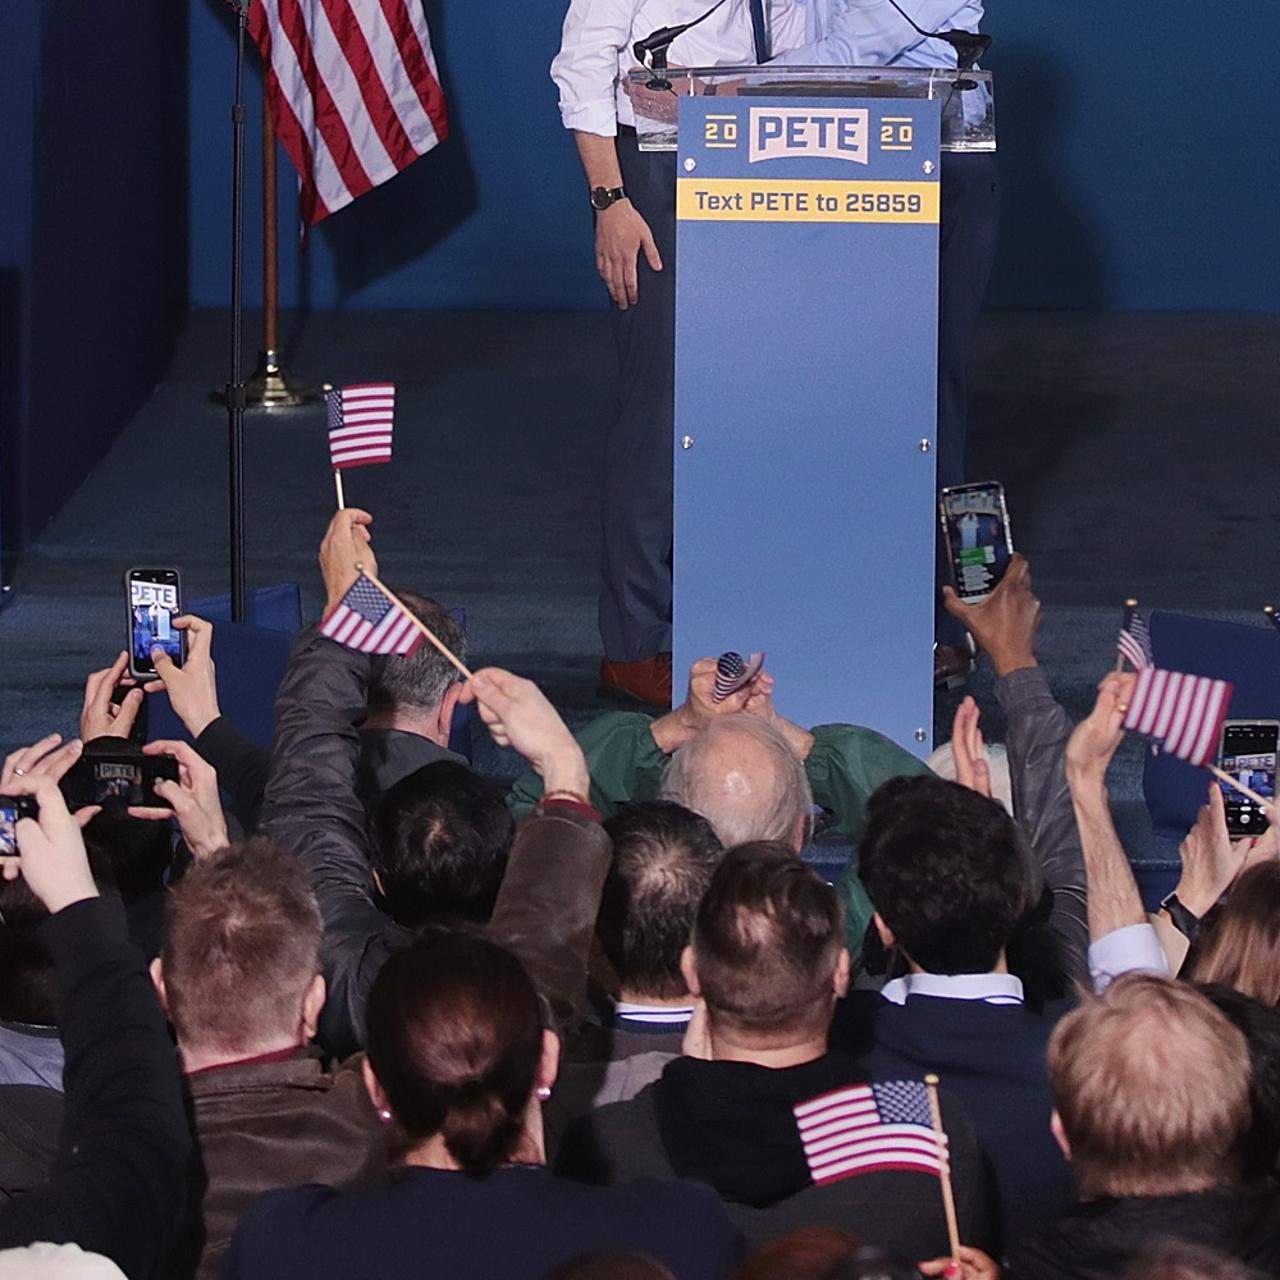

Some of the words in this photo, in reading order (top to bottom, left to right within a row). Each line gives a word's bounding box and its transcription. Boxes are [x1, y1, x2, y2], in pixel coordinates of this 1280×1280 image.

[705, 123, 736, 140] 20
[758, 116, 860, 152] PETE
[880, 125, 913, 143] 20
[695, 191, 743, 211] Text
[750, 192, 809, 212] PETE
[815, 193, 839, 212] to
[845, 194, 922, 213] 25859
